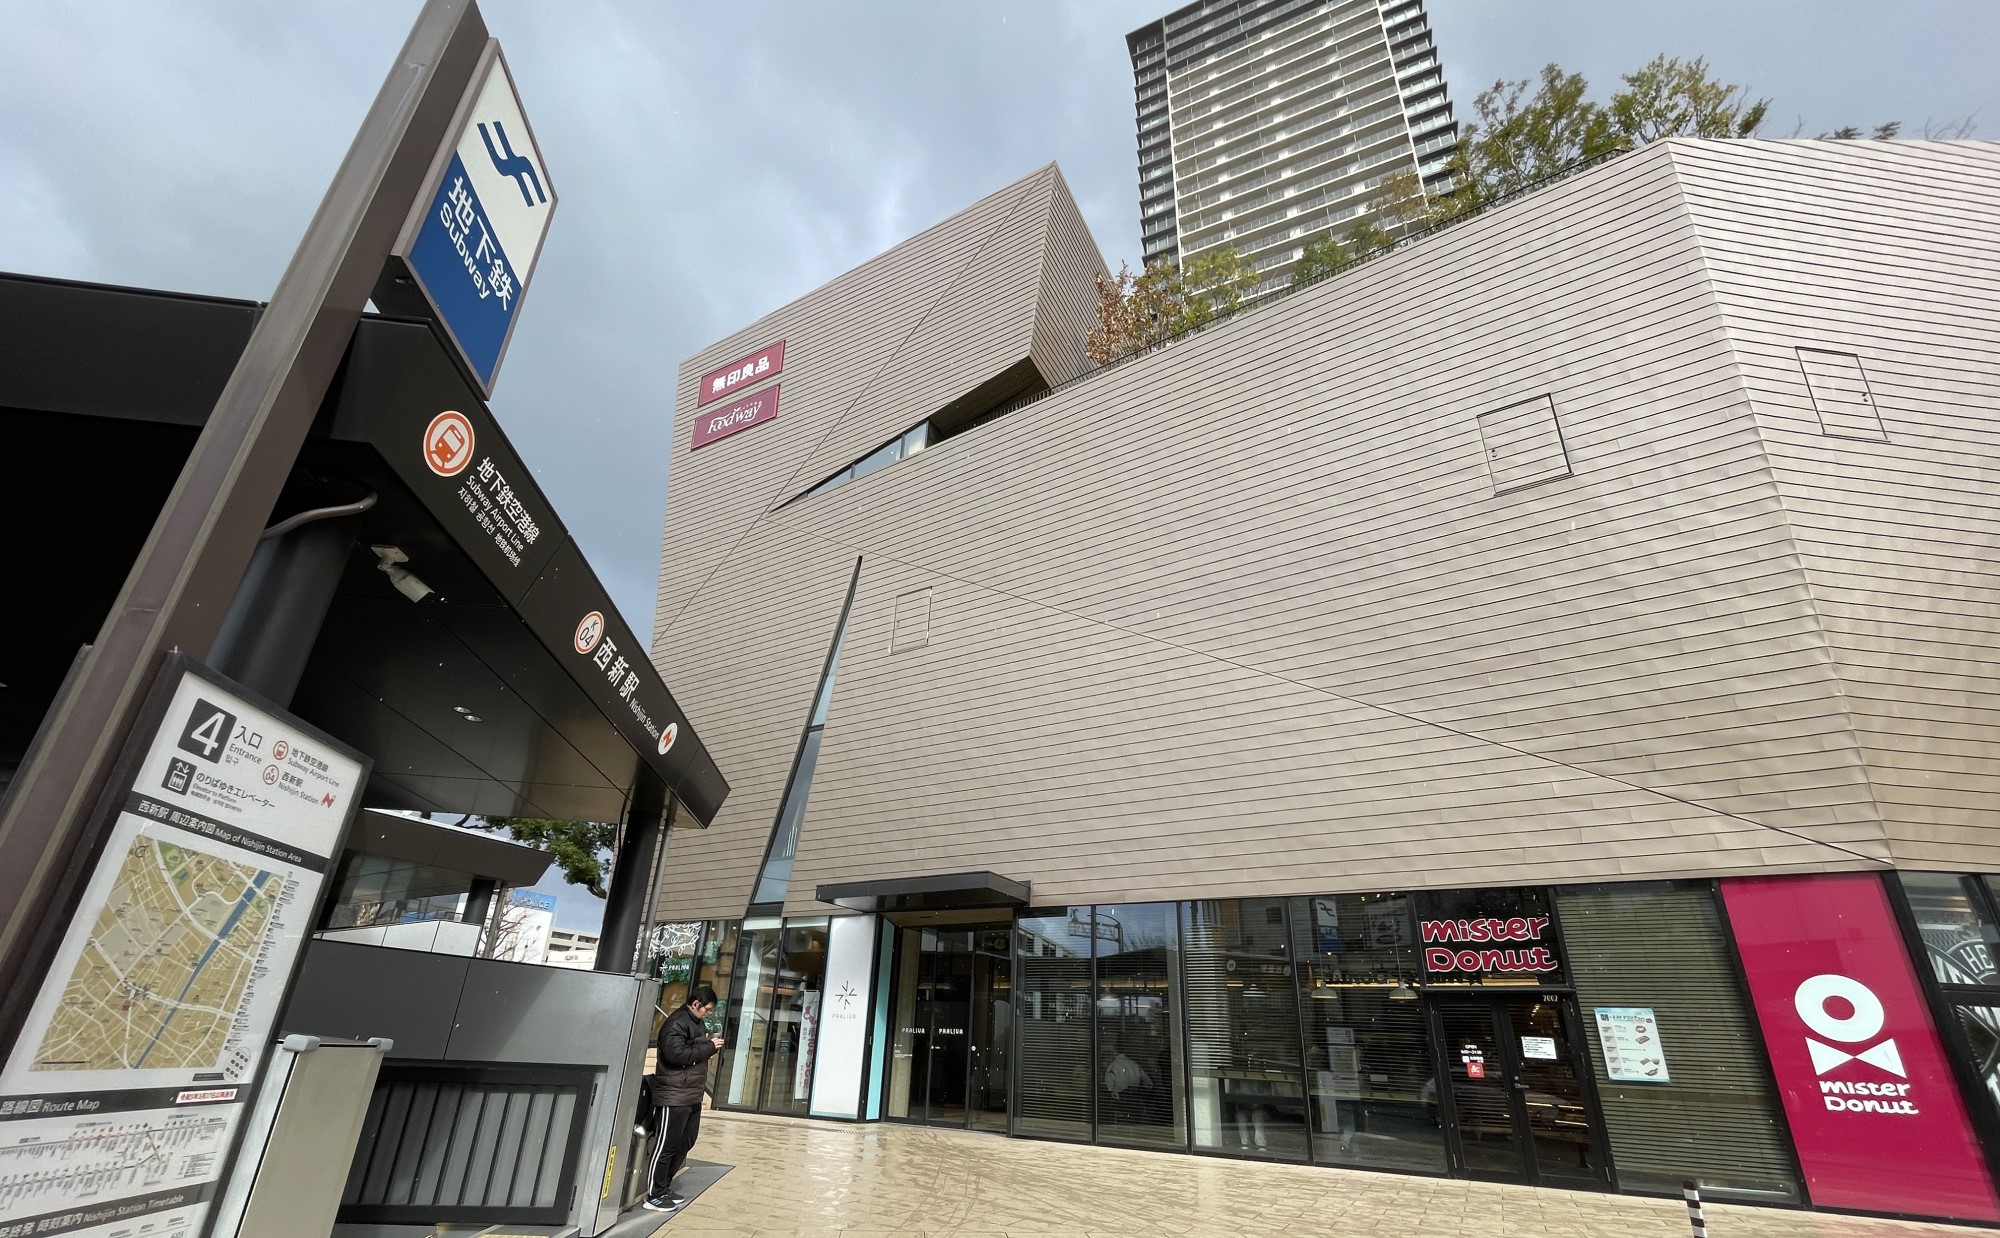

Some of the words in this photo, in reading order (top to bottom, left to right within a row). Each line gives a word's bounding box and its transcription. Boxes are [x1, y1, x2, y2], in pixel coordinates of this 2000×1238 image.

[440, 202, 490, 299] Subway
[448, 176, 513, 310] 地下鉄
[712, 356, 769, 393] 無印良品
[707, 401, 762, 434] Foodway
[458, 487, 479, 513] 지하철
[476, 510, 496, 535] 공항선
[466, 475, 492, 511] Subway
[490, 508, 513, 537] Airport
[511, 533, 523, 551] Line
[477, 457, 540, 544] 地下鉄空港線
[580, 627, 595, 648] 04
[590, 620, 599, 631] K
[593, 636, 640, 702] 西新駅
[191, 712, 226, 756] 4
[628, 698, 646, 721] Nishijin
[644, 717, 660, 740] Station
[229, 743, 262, 764] Entrance
[234, 726, 262, 749] 入口
[266, 773, 275, 782] 04
[282, 772, 304, 788] 西新駅
[288, 758, 309, 774] Subway
[309, 768, 329, 782] Airport
[328, 778, 340, 787] Line
[196, 773, 275, 807] のりばゆきエレベーター
[300, 791, 319, 804] Station
[138, 800, 170, 819] 西新駅
[170, 811, 216, 835] 周辺案内図
[215, 828, 231, 841] Map
[232, 835, 241, 843] of
[241, 837, 265, 851] Nishijin
[265, 845, 288, 859] Station
[288, 852, 302, 862] Area
[1425, 947, 1558, 972] Donut
[42, 1100, 74, 1113] Route
[76, 1099, 100, 1112] Map
[1823, 1096, 1919, 1114] Donut
[83, 1209, 116, 1223] Nishijin
[117, 1203, 146, 1216] Station
[147, 1195, 184, 1208] Timetable
